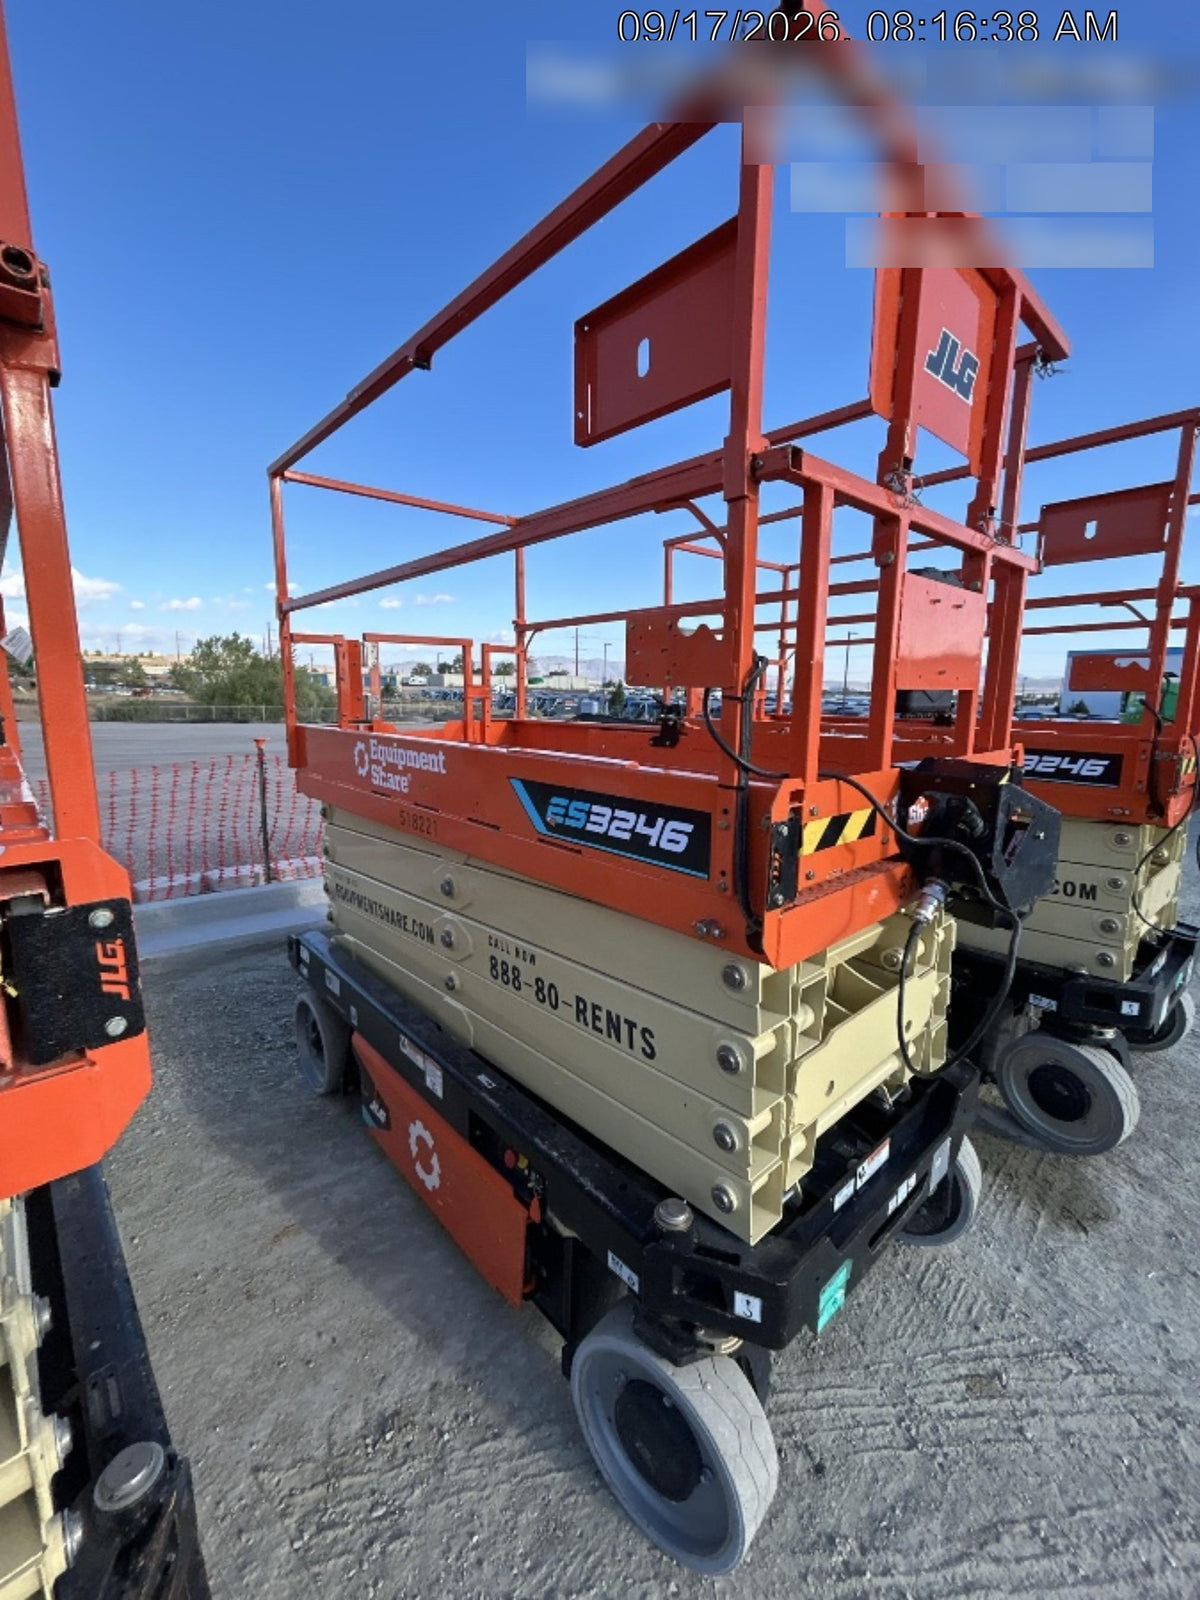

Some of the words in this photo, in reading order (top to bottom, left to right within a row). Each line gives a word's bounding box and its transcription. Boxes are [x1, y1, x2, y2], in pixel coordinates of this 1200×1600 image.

[924, 327, 980, 406] JLG
[369, 739, 447, 774] Equipment
[546, 796, 695, 853] ES3246
[95, 936, 131, 1001] JLG
[488, 934, 511, 955] CALL
[489, 954, 657, 1061] 888-80-RENTS
